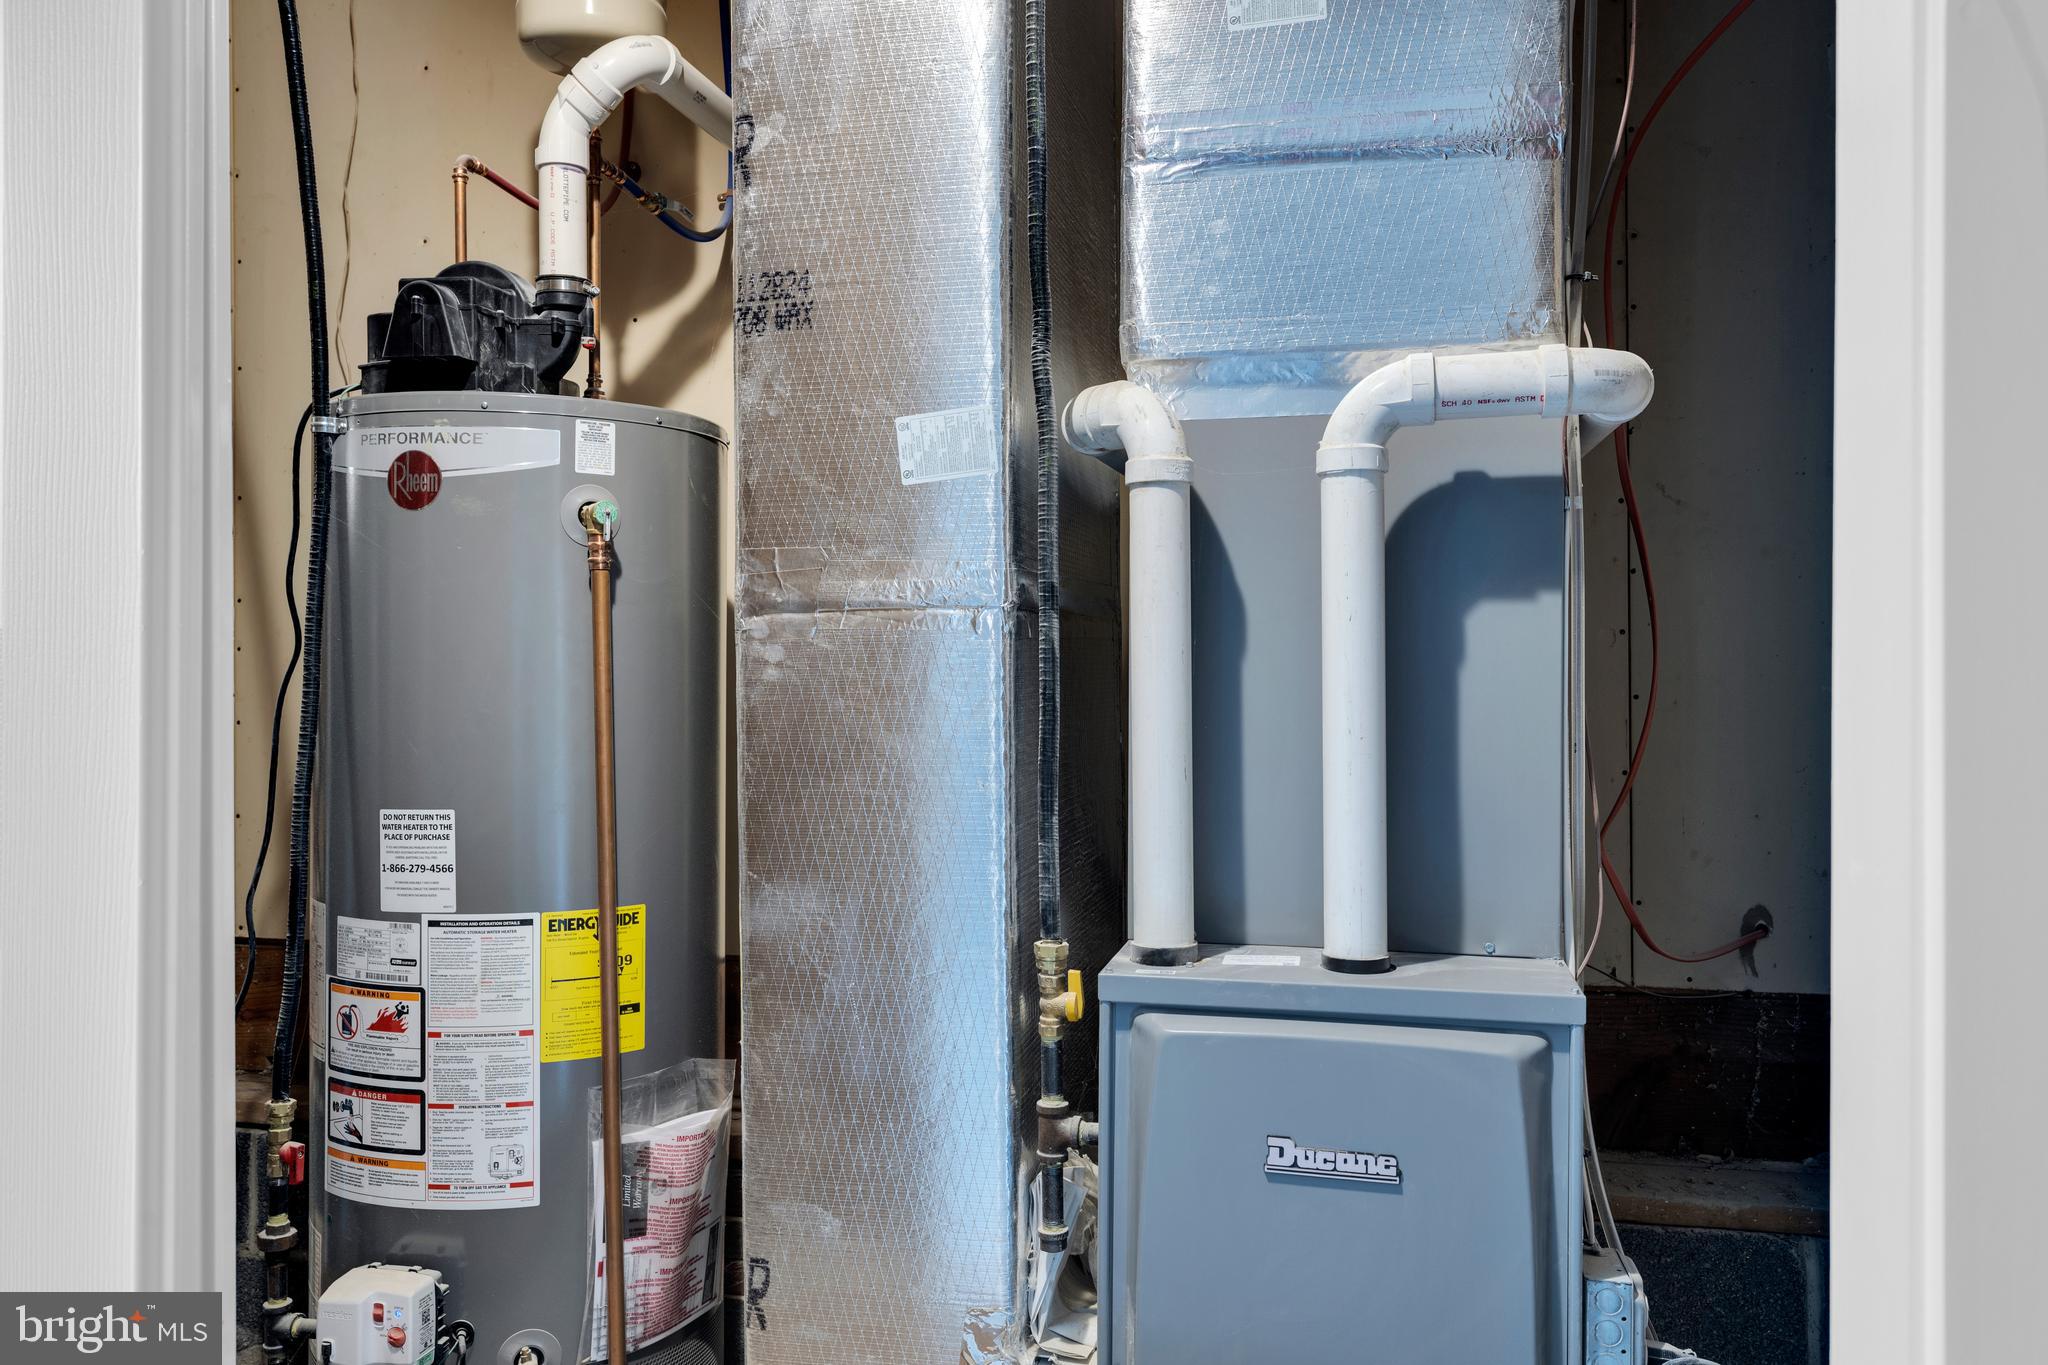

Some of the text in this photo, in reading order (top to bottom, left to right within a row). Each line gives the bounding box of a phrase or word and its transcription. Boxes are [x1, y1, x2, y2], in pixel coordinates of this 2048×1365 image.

[1441, 400, 1457, 408] SCH
[1515, 395, 1536, 403] ASTM
[361, 432, 484, 446] PERFORMANCE
[394, 451, 438, 500] Rheem
[383, 813, 451, 821] DO NOT RETURN THIS
[382, 823, 453, 831] WATER HEATER TO THE
[384, 833, 450, 841] PLACE OF PURCHASE
[382, 863, 454, 873] 1-866-279-4566
[356, 989, 390, 999] WARNING
[358, 1090, 387, 1101] DANGER
[676, 1129, 710, 1142] IMPORTA
[1266, 1135, 1398, 1177] Ducane
[357, 1157, 389, 1167] WARNING
[622, 1174, 632, 1207] Limited
